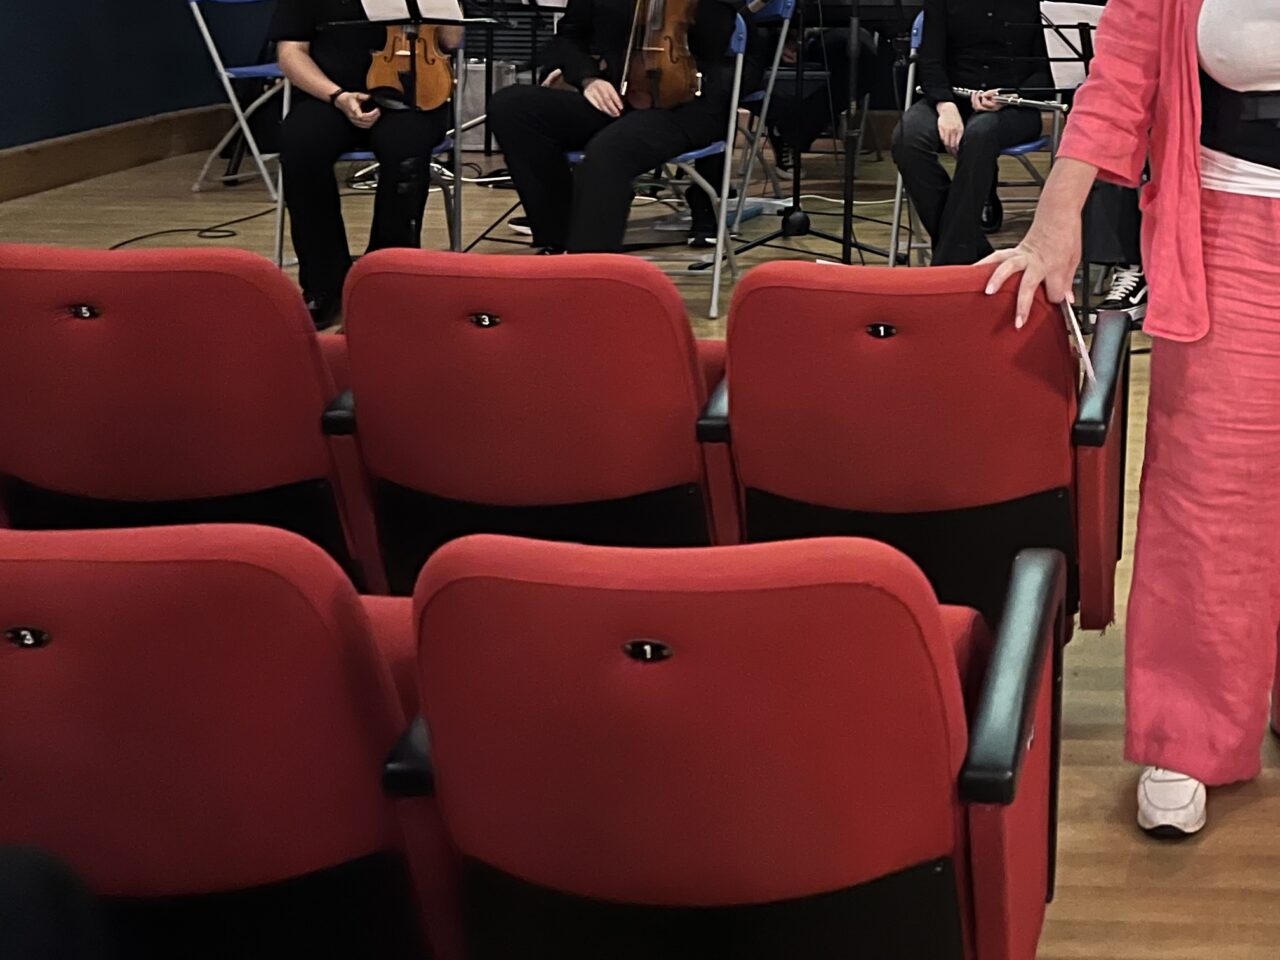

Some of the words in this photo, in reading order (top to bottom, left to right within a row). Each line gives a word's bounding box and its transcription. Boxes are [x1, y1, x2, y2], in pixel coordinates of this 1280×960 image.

[81, 306, 90, 317] 5
[481, 315, 490, 325] 3
[879, 325, 885, 336] 1
[643, 644, 652, 659] 1
